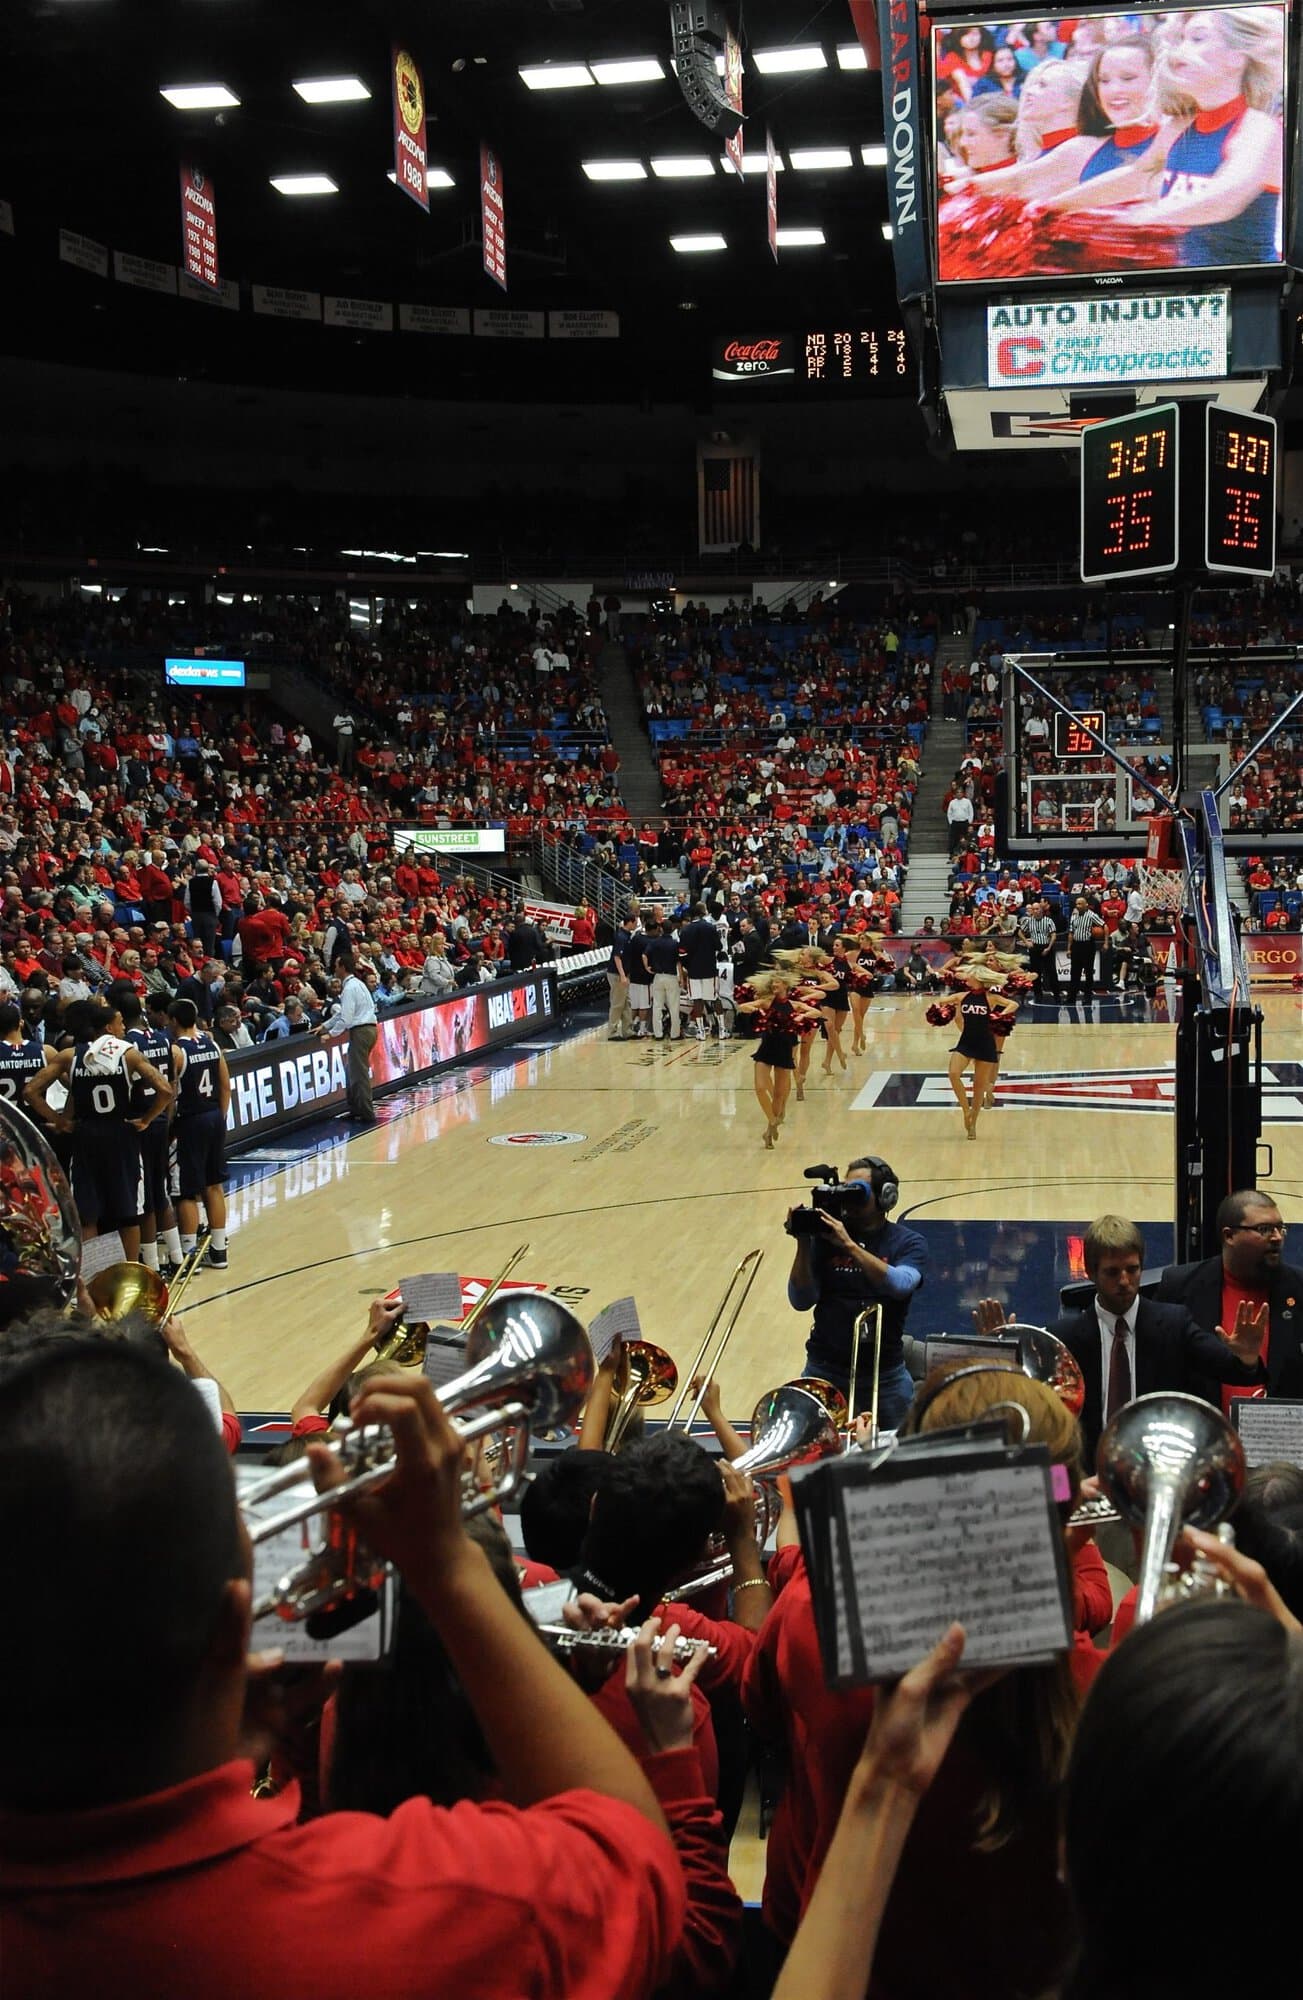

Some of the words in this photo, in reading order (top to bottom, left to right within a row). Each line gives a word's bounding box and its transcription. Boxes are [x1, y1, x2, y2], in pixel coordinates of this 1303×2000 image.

[398, 130, 426, 167] ARIZONA
[893, 88, 917, 226] DOWN
[403, 159, 422, 193] 1988
[185, 186, 215, 215] ARIZONA
[186, 211, 206, 230] SWEET
[992, 305, 1077, 328] AUTO
[1088, 296, 1224, 325] INJURY?
[805, 345, 827, 357] PTS
[836, 344, 852, 355] 18
[870, 342, 879, 353] 5
[897, 341, 905, 352] 7
[807, 334, 825, 345] NO
[834, 333, 852, 344] 20
[860, 331, 875, 342] 21
[887, 330, 905, 341] 24
[808, 356, 825, 368] RB
[843, 355, 852, 366] 2
[870, 354, 879, 365] 4
[897, 352, 905, 363] 4
[843, 366, 852, 377] 2
[870, 365, 879, 376] 4
[896, 363, 906, 375] 0
[1051, 347, 1214, 376] Chiropractic
[1108, 430, 1167, 479] 3:27
[1226, 432, 1270, 475] 3:27
[1104, 490, 1153, 555] 35
[1223, 488, 1260, 549] 35
[1066, 733, 1092, 752] 35
[417, 832, 477, 845] SUNSTREET
[858, 958, 876, 967] CAT
[1243, 949, 1298, 965] ARGO
[961, 1004, 988, 1015] CATS
[0, 1058, 42, 1070] ANTOPHLET
[188, 1051, 219, 1065] HERRERA
[198, 1068, 214, 1097] 4
[92, 1084, 116, 1114] 0
[226, 1066, 278, 1132] THE
